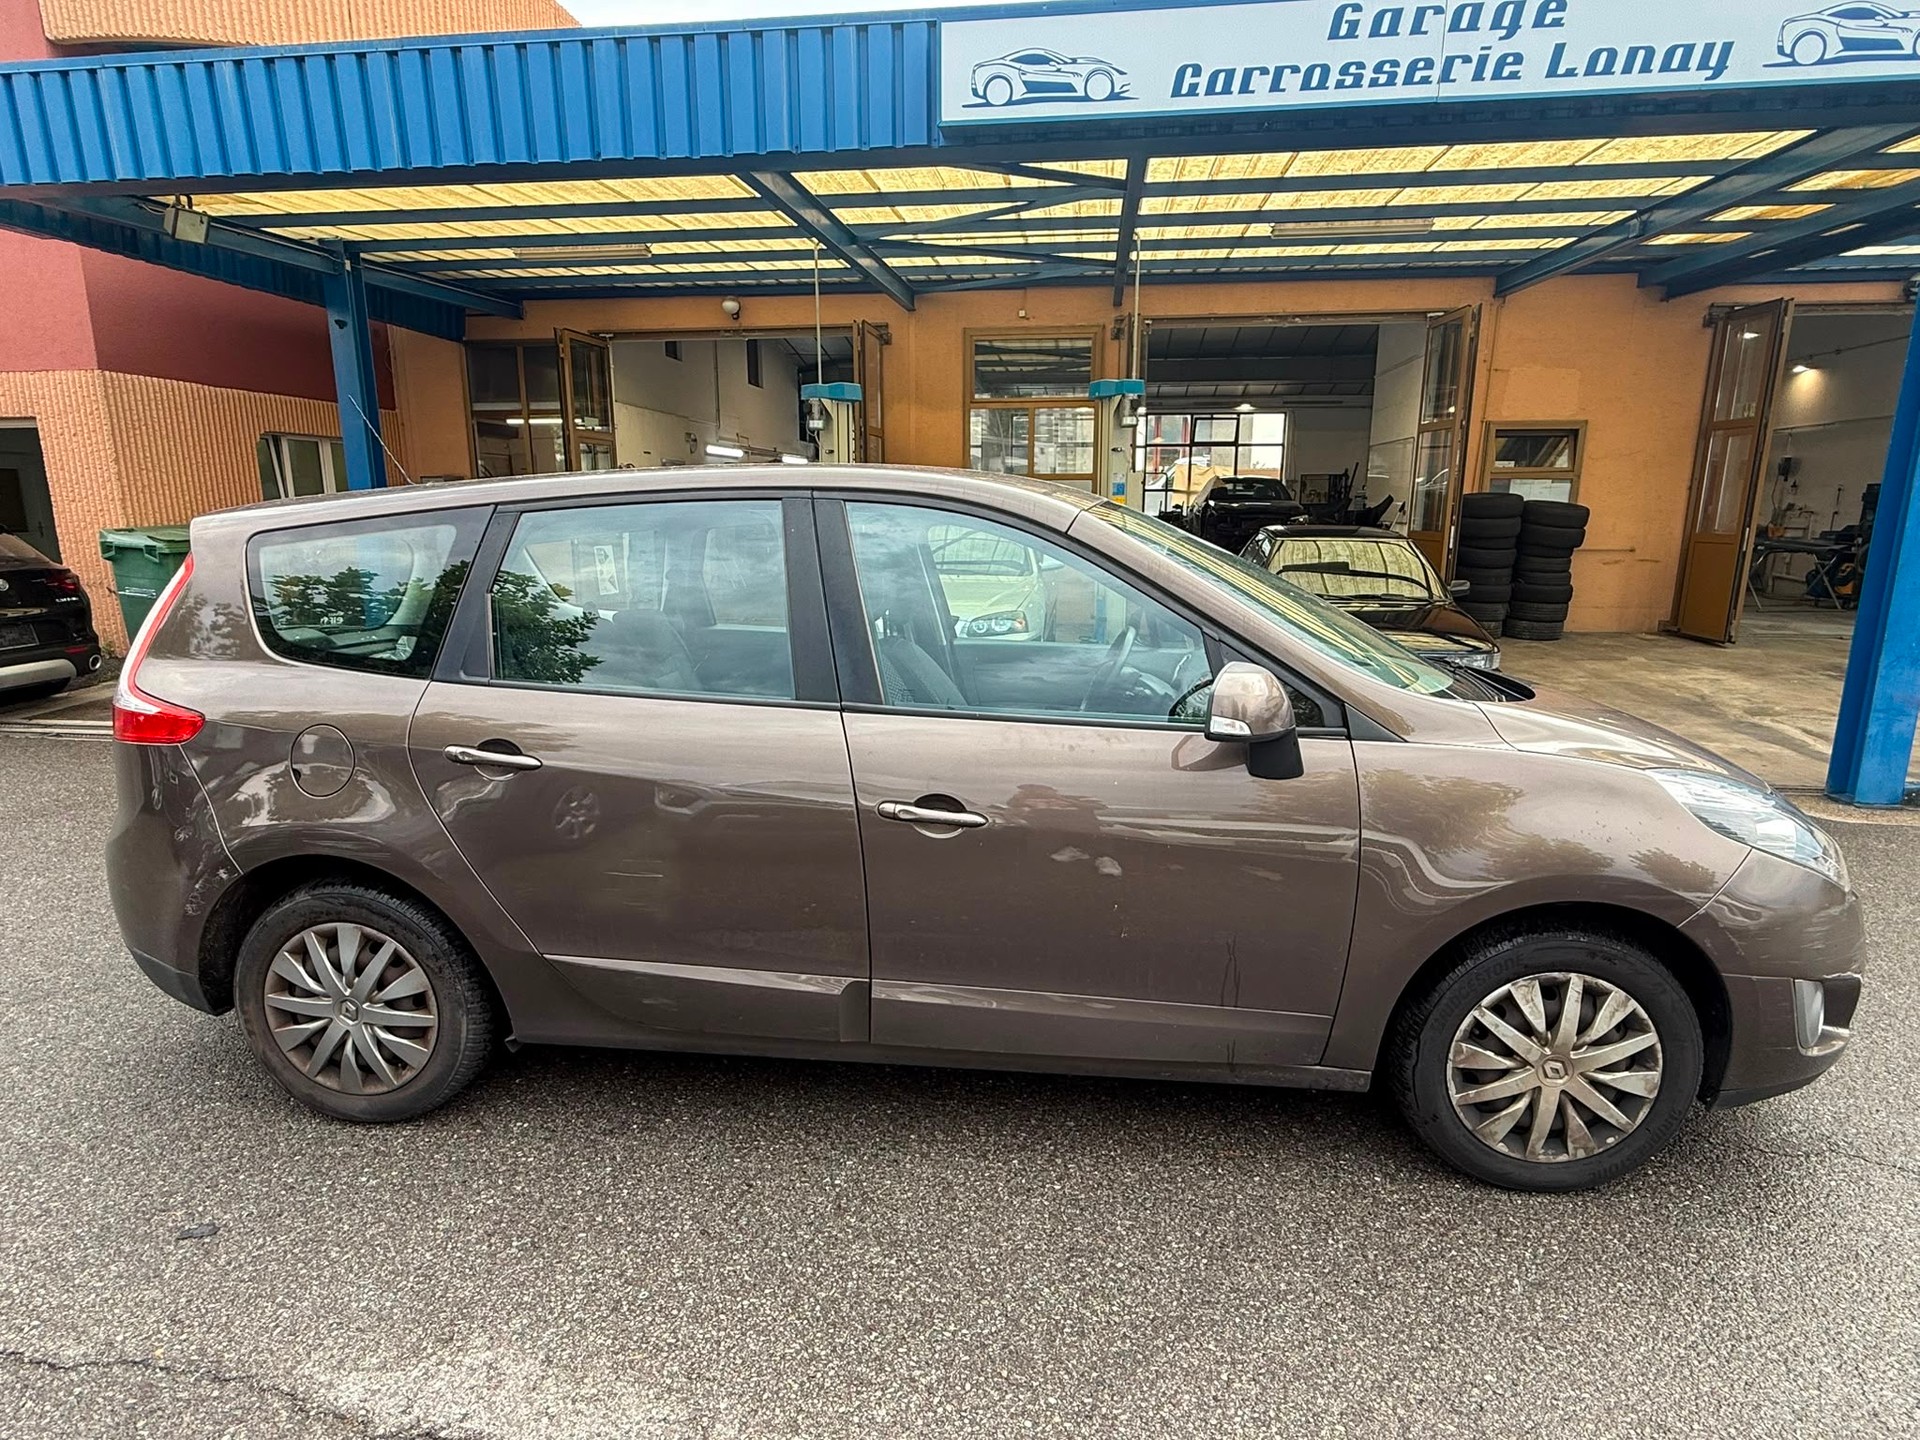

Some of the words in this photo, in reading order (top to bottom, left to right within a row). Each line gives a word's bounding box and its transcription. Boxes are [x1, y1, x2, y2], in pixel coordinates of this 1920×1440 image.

[1327, 0, 1568, 41] Garage
[1171, 46, 1524, 98] Carrosserie
[1545, 41, 1735, 81] Lonay
